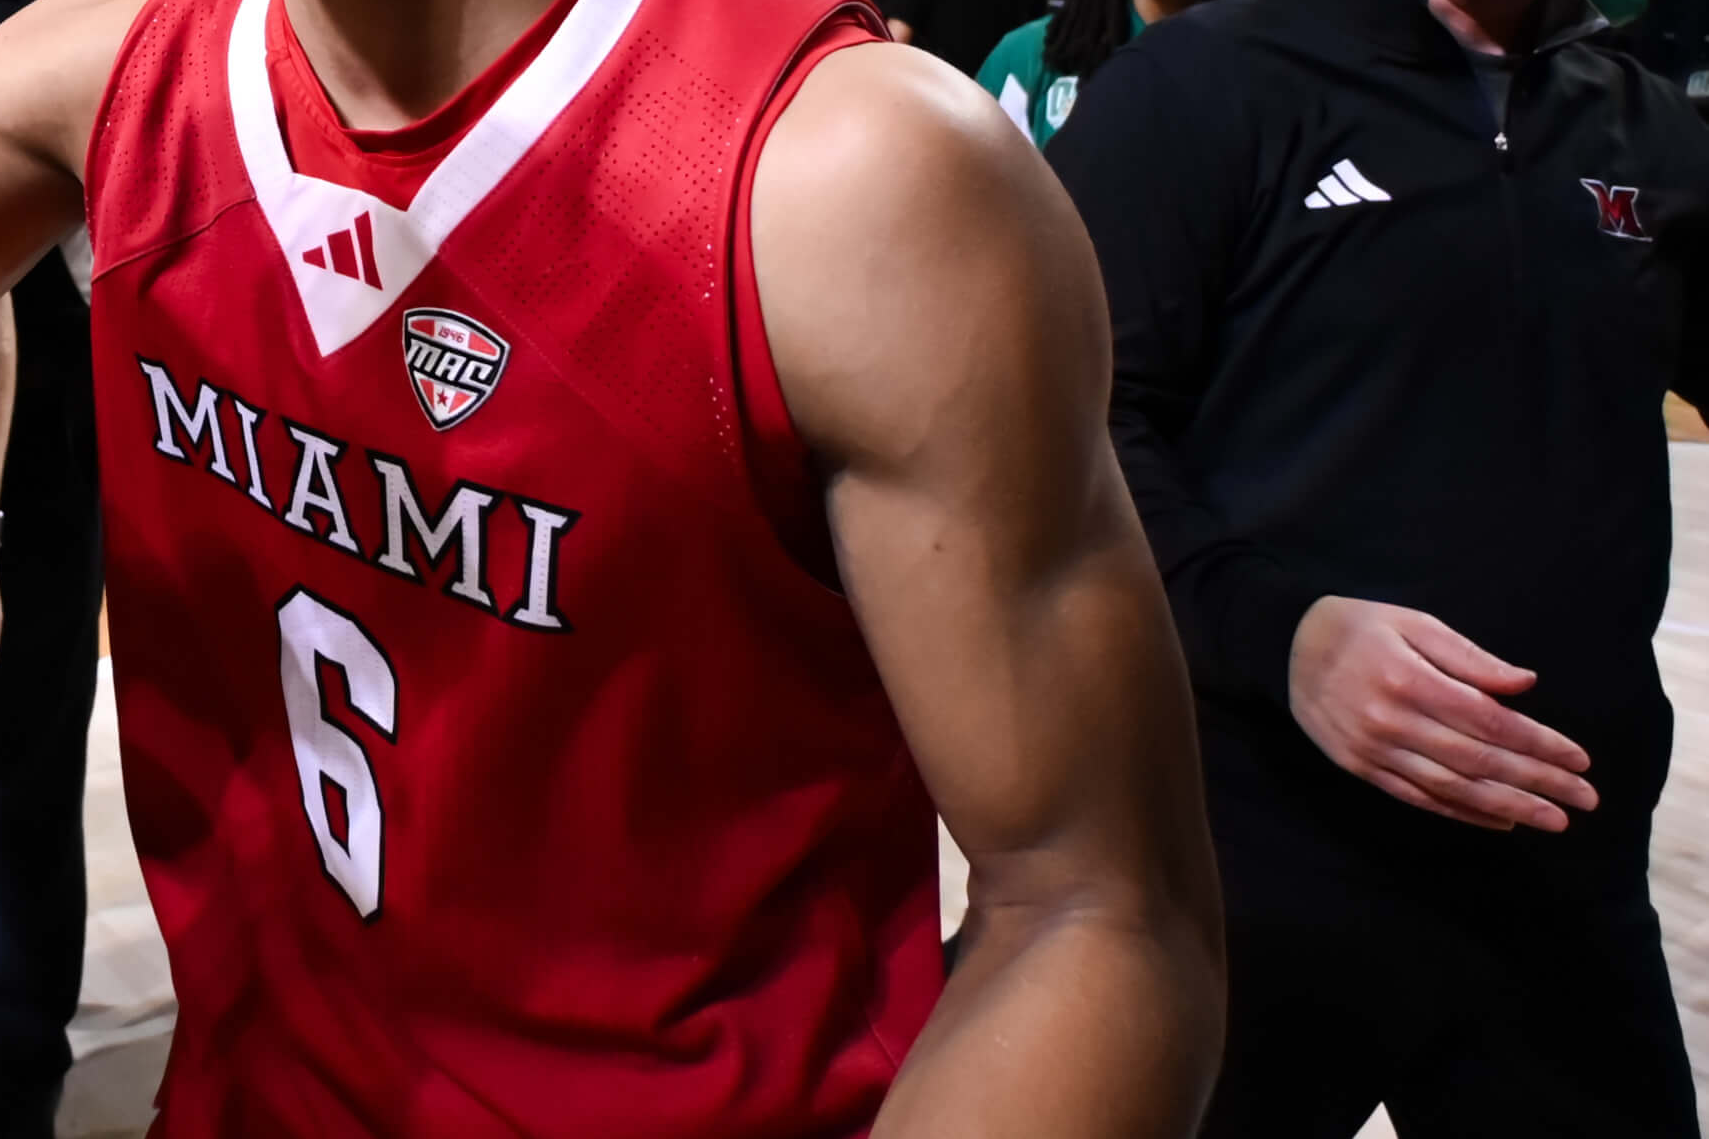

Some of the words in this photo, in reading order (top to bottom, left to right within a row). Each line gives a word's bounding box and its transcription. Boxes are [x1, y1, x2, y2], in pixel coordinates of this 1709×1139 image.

[136, 355, 580, 632] MIAMI
[406, 337, 495, 390] MAC
[275, 583, 398, 926] 6
